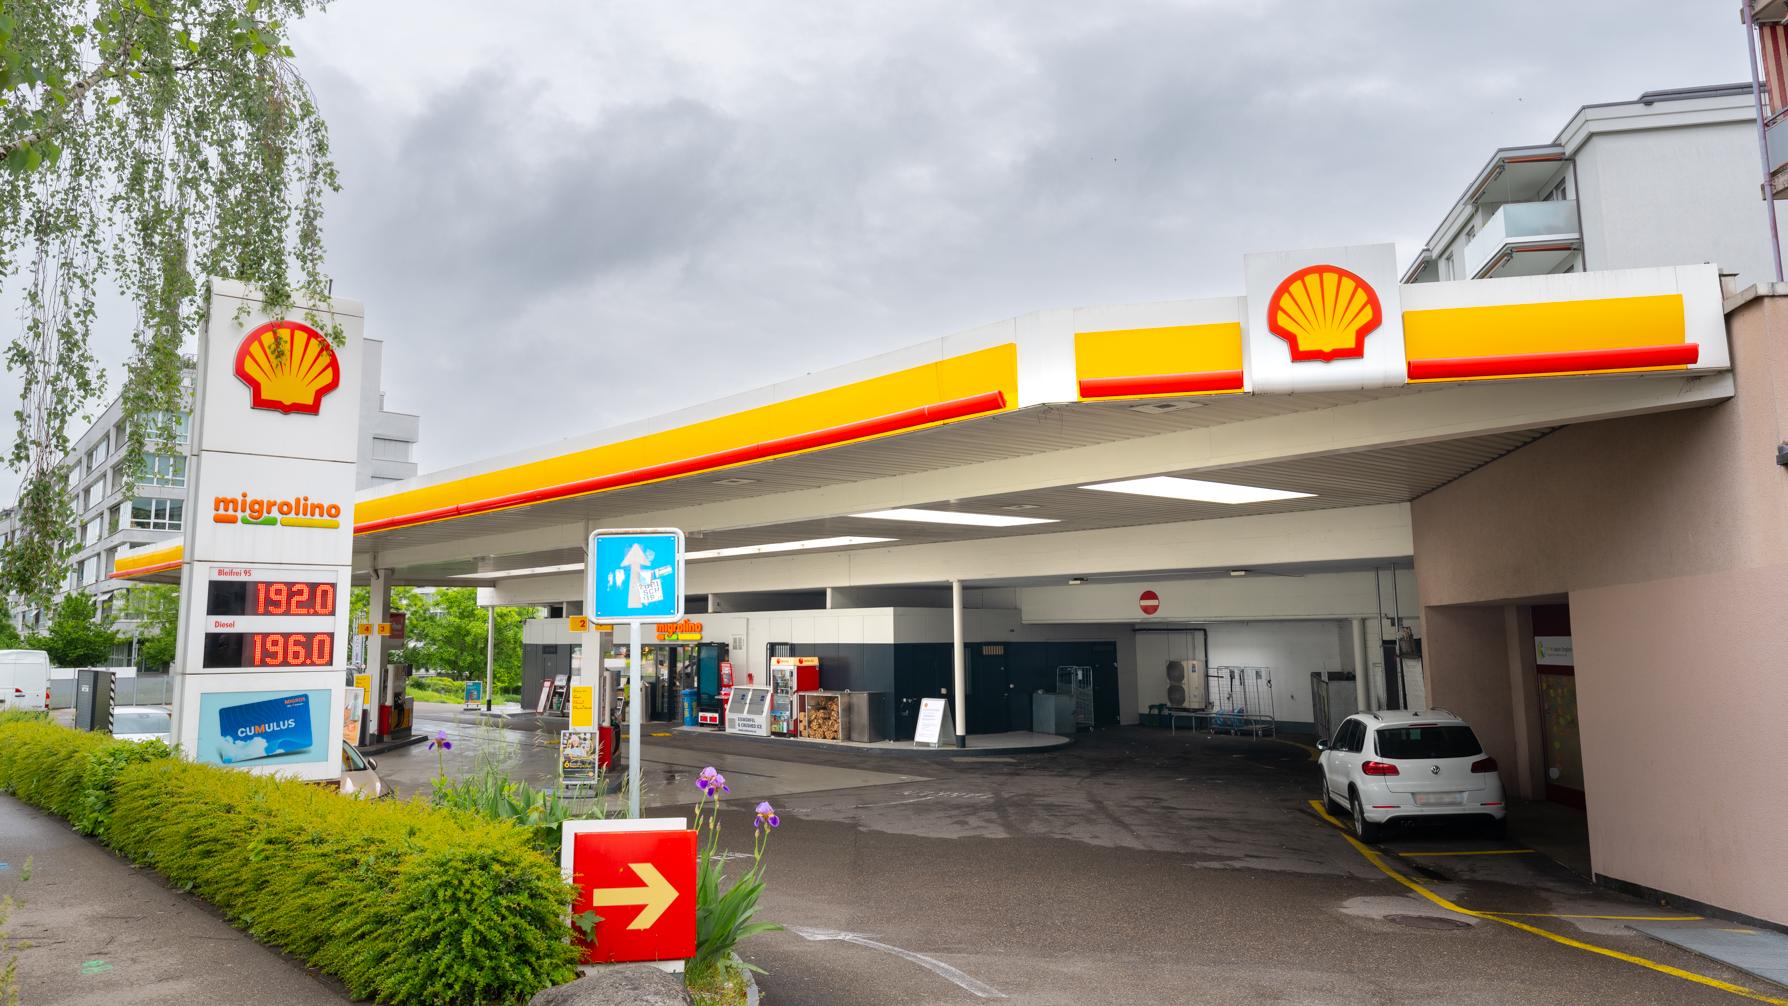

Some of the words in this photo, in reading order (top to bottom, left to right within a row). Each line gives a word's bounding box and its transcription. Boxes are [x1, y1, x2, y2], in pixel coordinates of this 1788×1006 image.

[214, 491, 341, 520] migrolino
[217, 568, 242, 577] Bleifrei
[243, 569, 252, 577] 95
[257, 583, 334, 615] 192.0
[214, 620, 236, 628] Diesel
[579, 619, 586, 628] 2
[656, 618, 703, 637] migrolino
[254, 634, 331, 665] 196.0
[237, 718, 296, 737] CUMULUS
